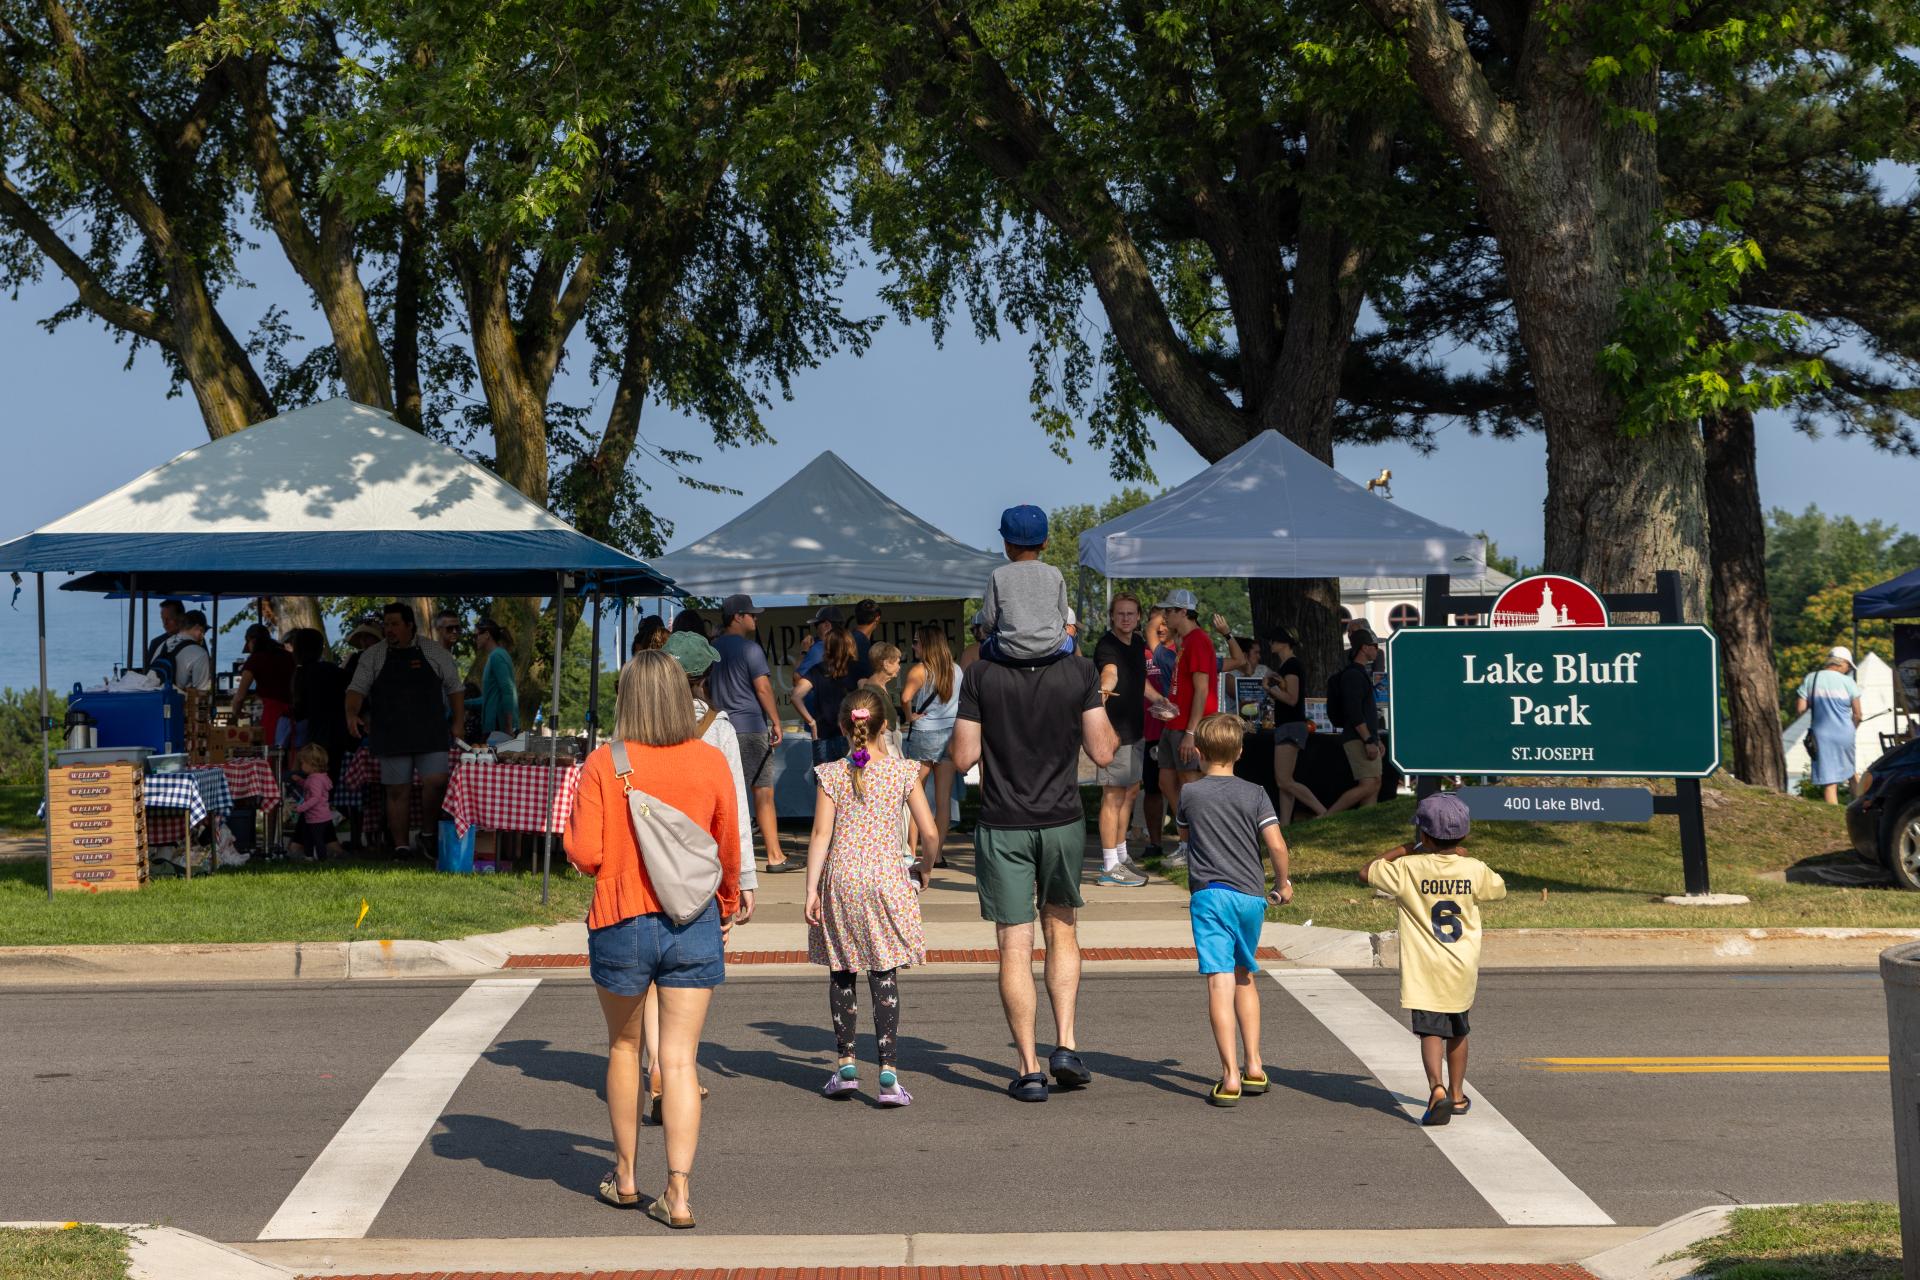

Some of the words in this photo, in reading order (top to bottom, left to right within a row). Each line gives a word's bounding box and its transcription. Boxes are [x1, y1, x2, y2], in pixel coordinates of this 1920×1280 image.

[1462, 653, 1544, 684] Lake
[1552, 652, 1642, 684] Bluff
[1510, 694, 1592, 726] Park
[1503, 797, 1531, 810] 400
[1535, 797, 1566, 811] Lake
[1570, 798, 1605, 811] Blvd.
[1421, 879, 1472, 895] COLVER
[1431, 900, 1463, 944] 6
